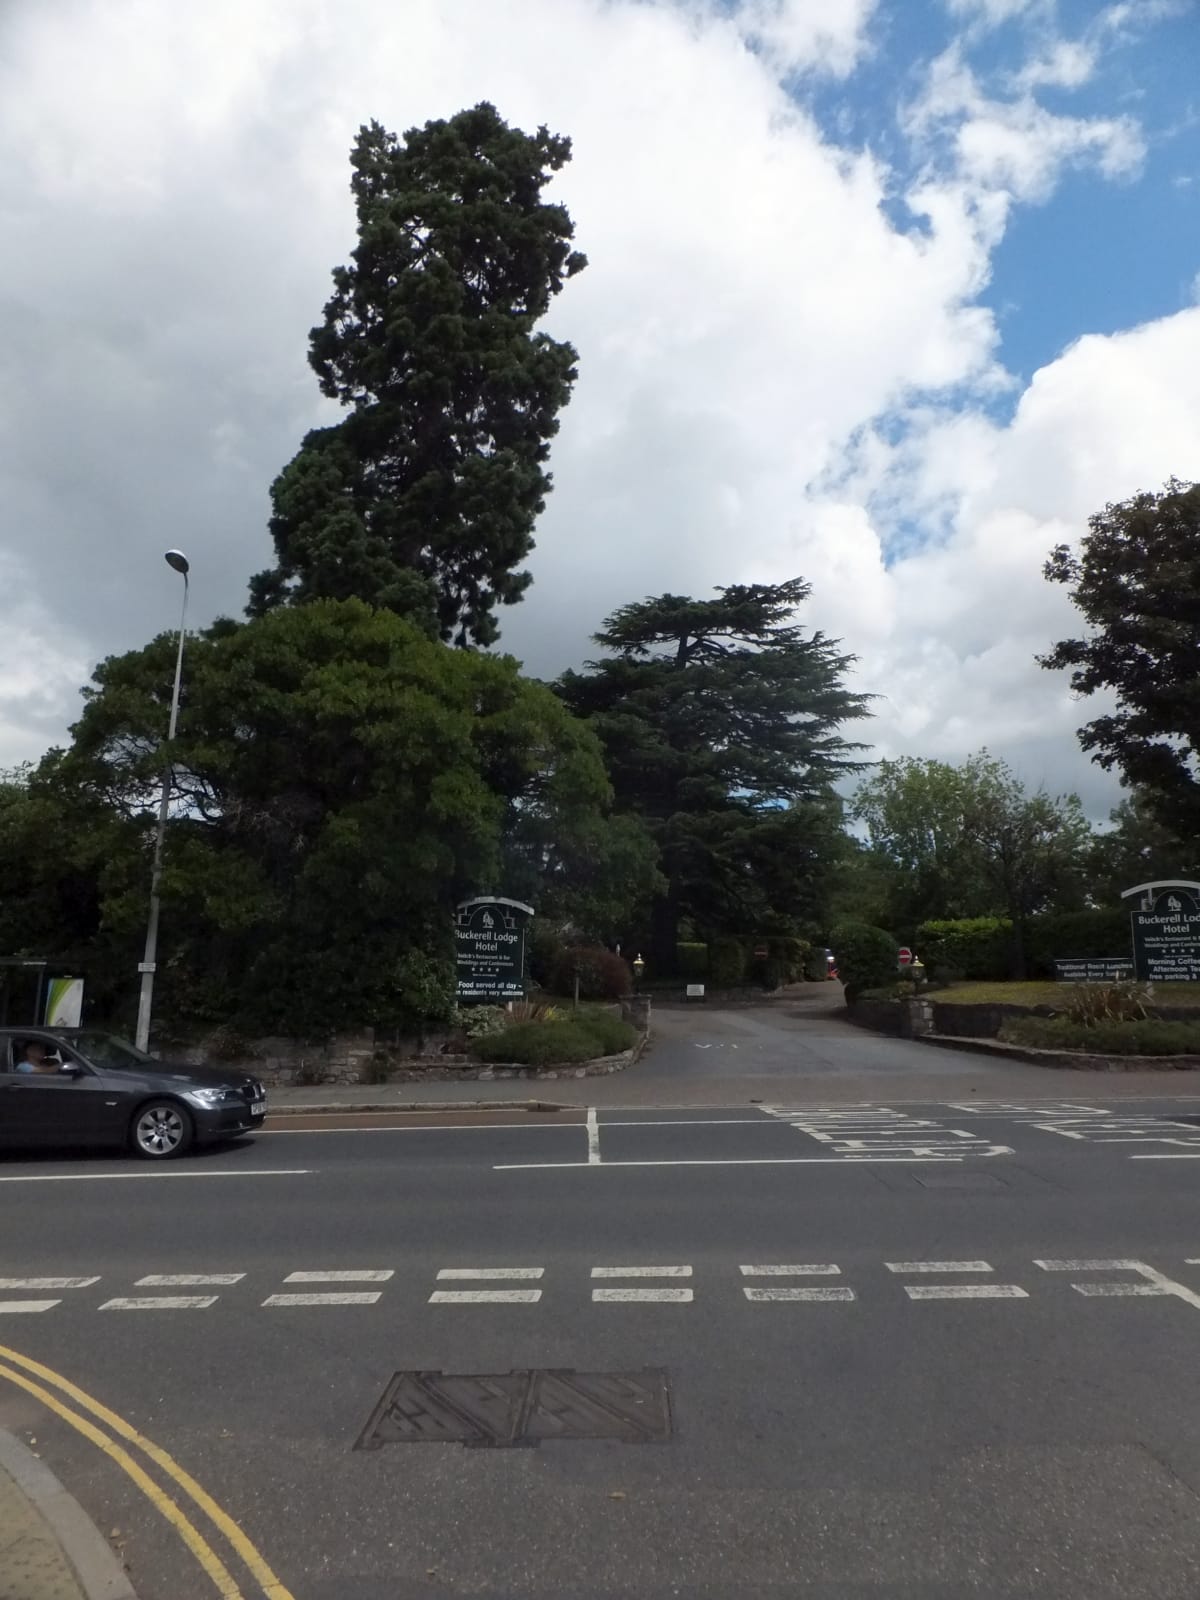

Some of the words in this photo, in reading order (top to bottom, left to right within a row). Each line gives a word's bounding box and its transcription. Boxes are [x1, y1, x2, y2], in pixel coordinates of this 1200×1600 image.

[1138, 914, 1181, 924] Buckerell
[1163, 924, 1190, 933] Hotel
[494, 932, 518, 944] Lodge
[476, 942, 498, 952] Hotel
[506, 982, 516, 990] day
